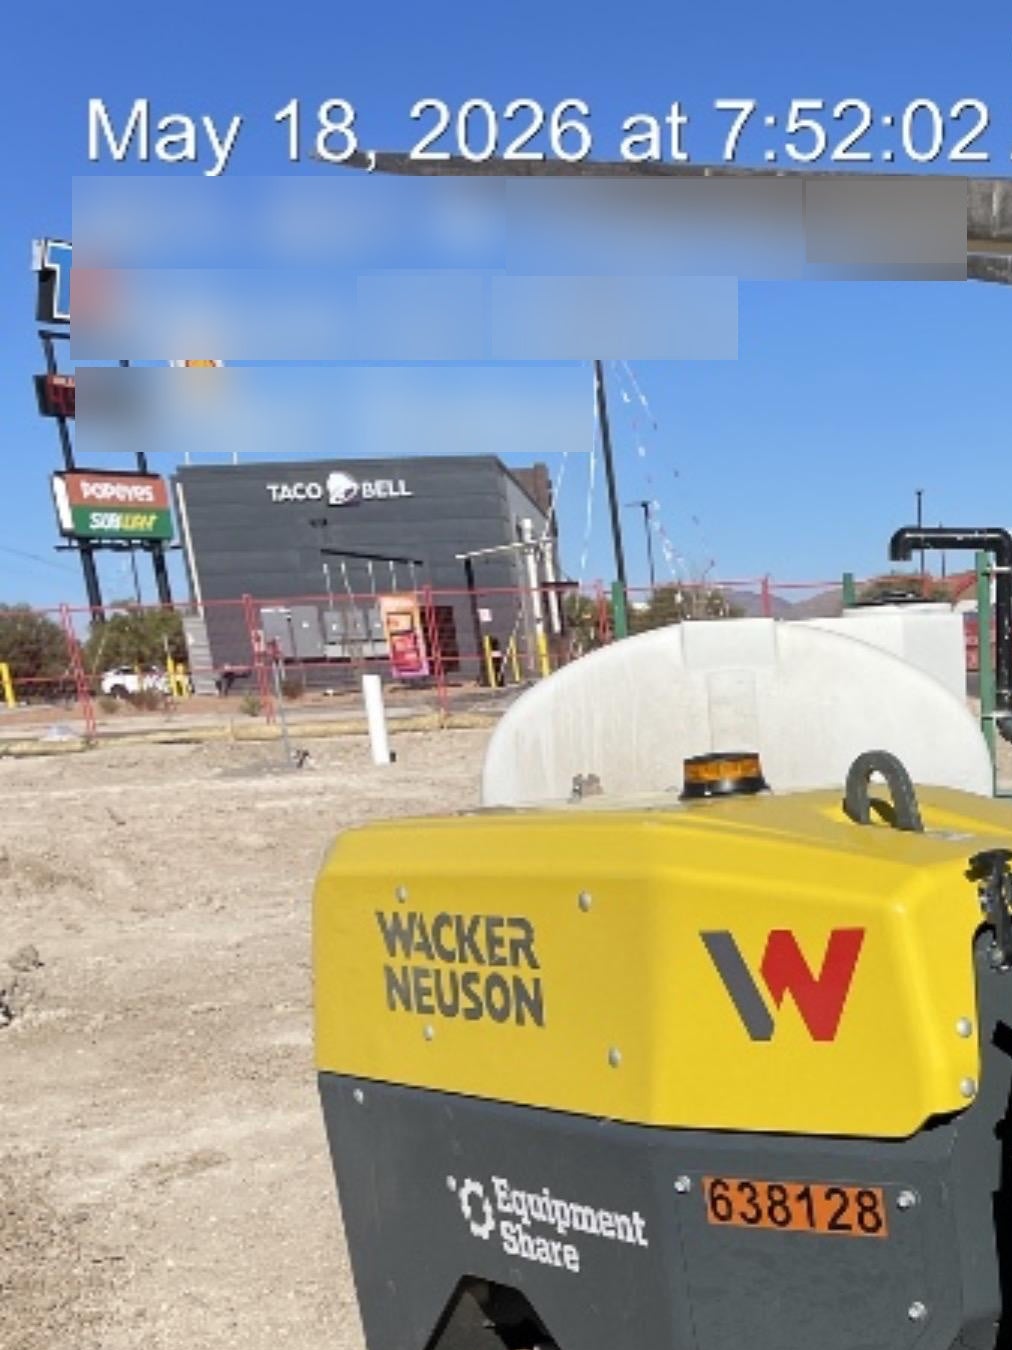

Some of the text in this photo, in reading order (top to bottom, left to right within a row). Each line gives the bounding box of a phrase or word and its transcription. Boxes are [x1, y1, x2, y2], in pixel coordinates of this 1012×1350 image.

[266, 479, 414, 502] TACO BELL
[89, 511, 158, 532] SUBWAY
[375, 910, 541, 970] WACKER
[383, 964, 547, 1028] NEUSON
[492, 1176, 649, 1248] Equipment
[707, 1177, 884, 1235] 638128
[500, 1219, 581, 1273] Share
